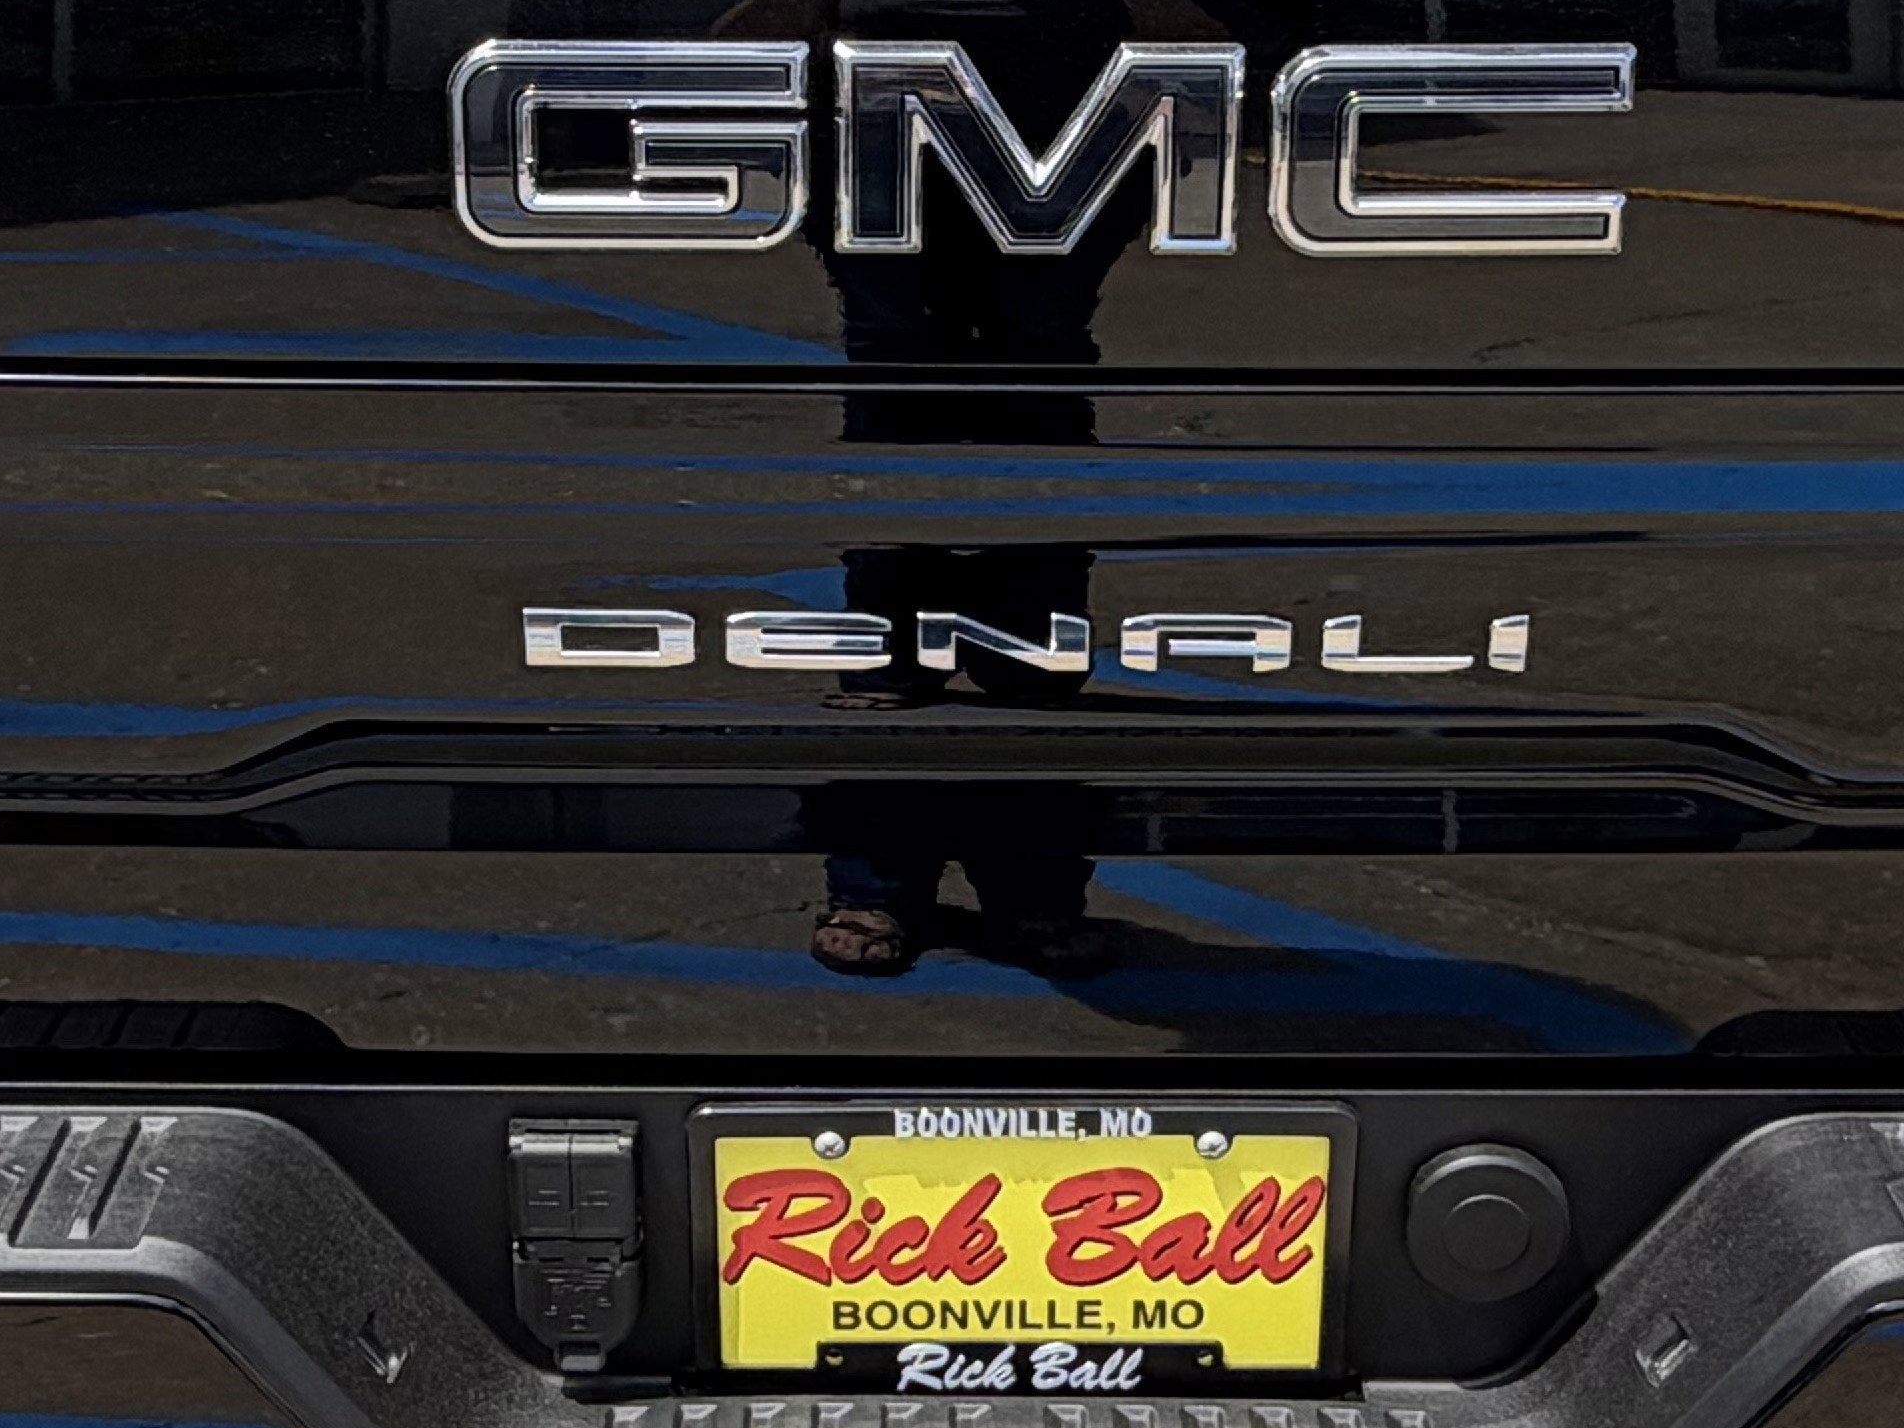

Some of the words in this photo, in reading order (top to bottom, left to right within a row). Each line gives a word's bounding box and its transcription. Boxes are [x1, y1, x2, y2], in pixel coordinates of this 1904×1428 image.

[446, 39, 1636, 256] GMC
[522, 607, 1530, 673] DENALI
[893, 1108, 1089, 1142] BOONVILLE,
[1099, 1108, 1153, 1137] MO
[723, 1168, 1006, 1288] Rick
[1042, 1167, 1326, 1285] Ball
[832, 1300, 1117, 1335] BOONVILLE,
[1132, 1299, 1205, 1330] MO
[896, 1342, 1018, 1392] Rick
[1030, 1344, 1143, 1391] Ball
